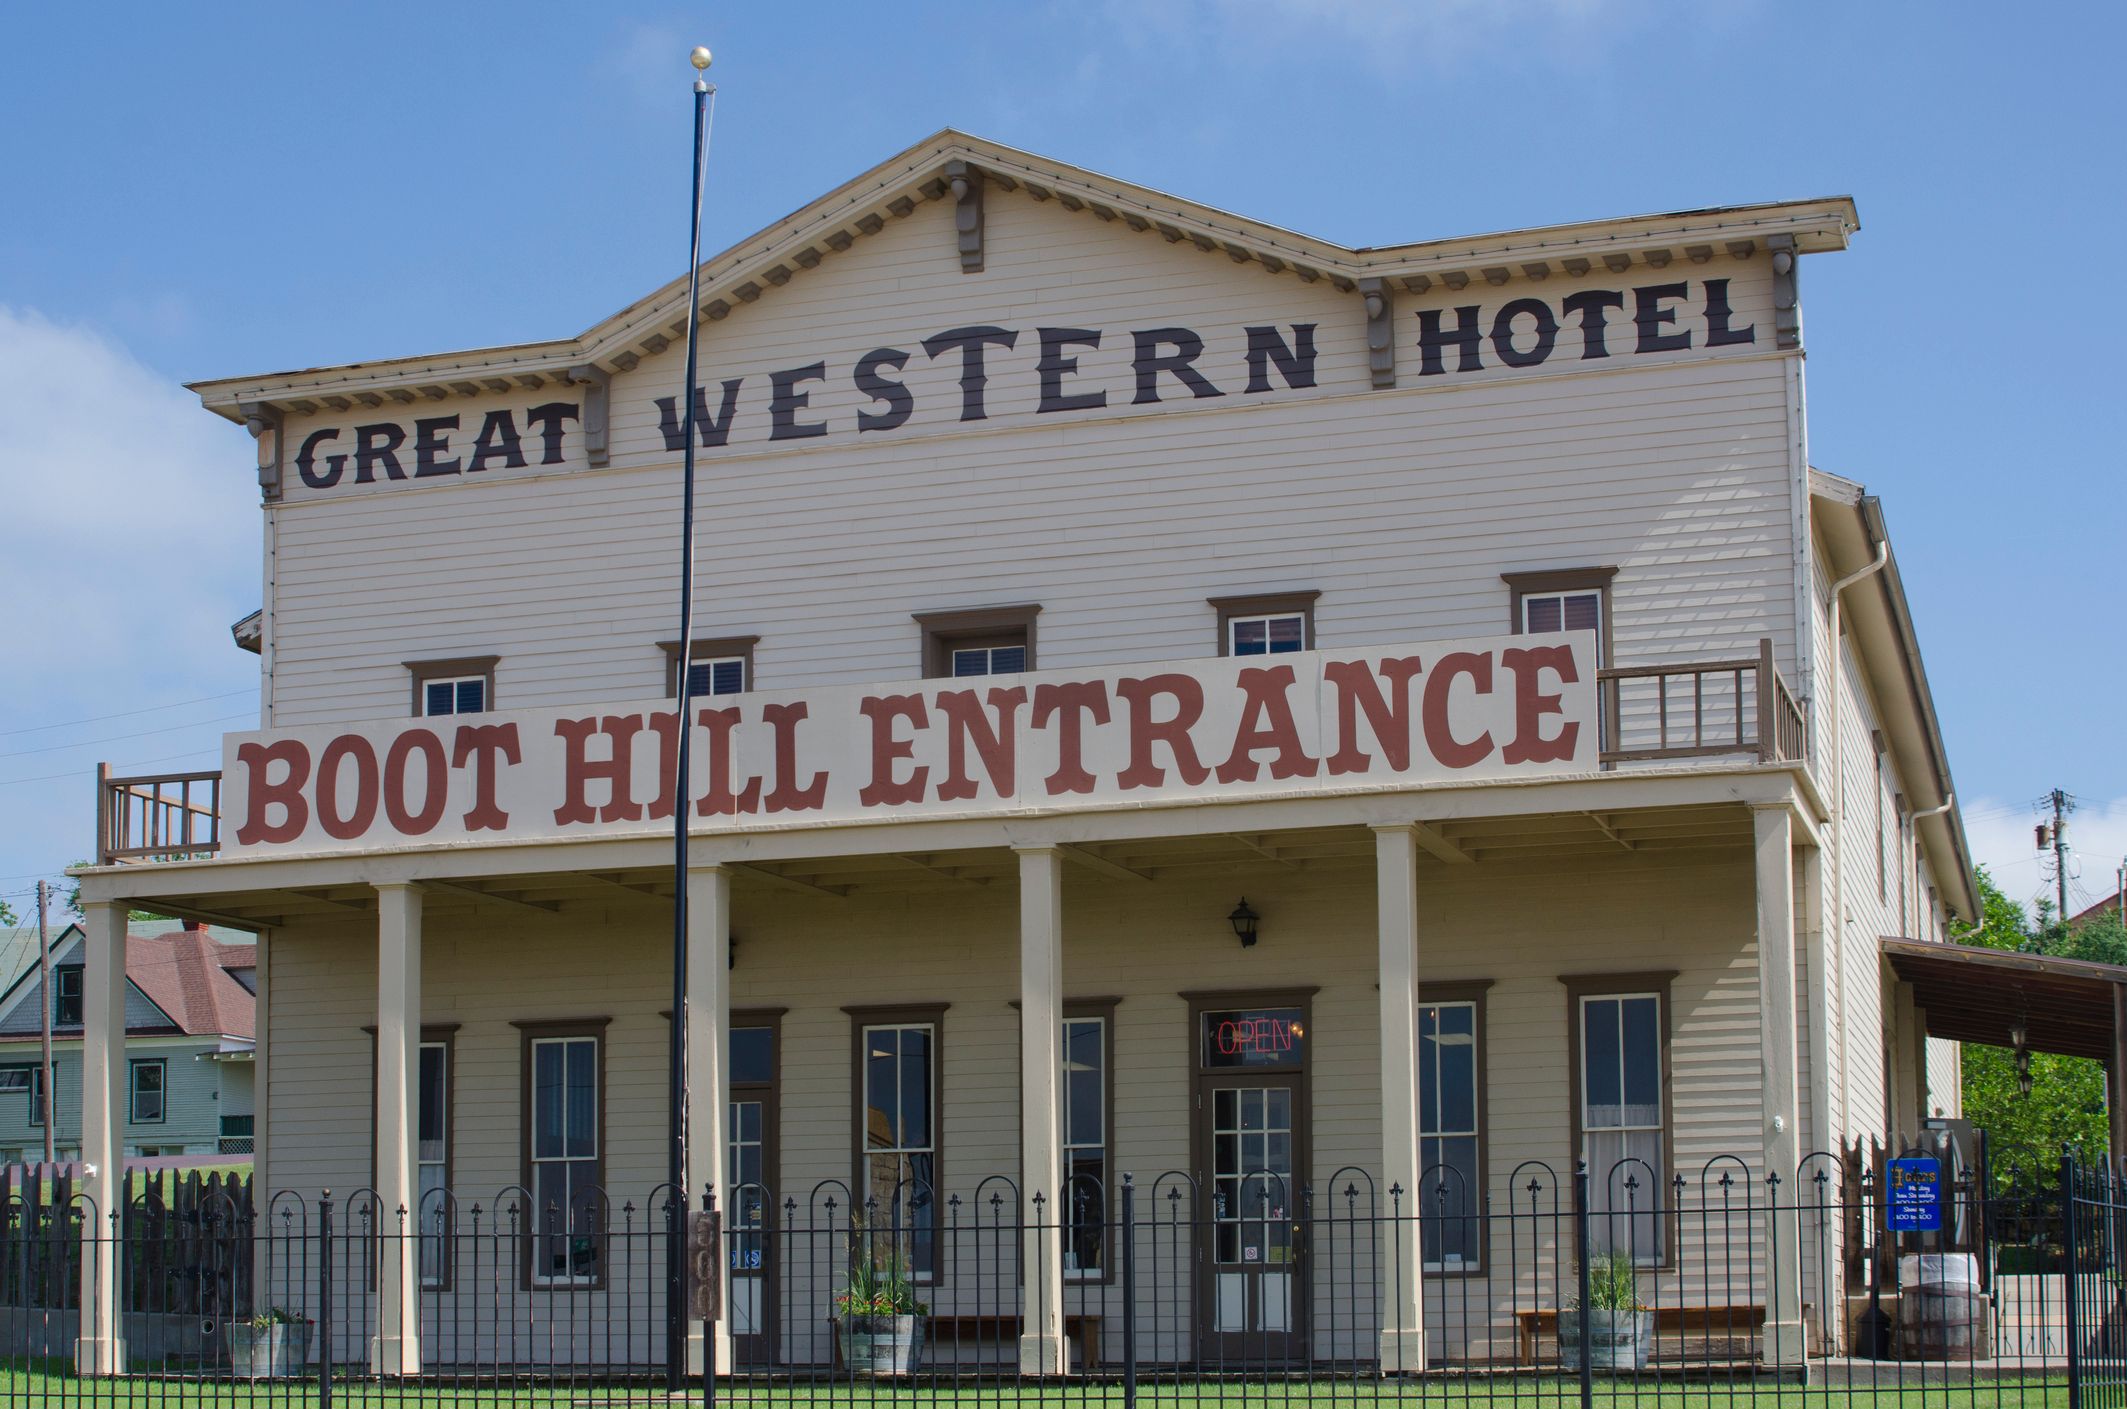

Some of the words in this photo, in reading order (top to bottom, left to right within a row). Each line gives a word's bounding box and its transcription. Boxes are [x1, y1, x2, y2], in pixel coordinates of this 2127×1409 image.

[294, 402, 579, 489] GREAT
[653, 323, 1319, 452] WESTERN
[1414, 278, 1755, 376] HOTEL
[236, 722, 522, 846] BOOT
[553, 700, 829, 826] HILL
[859, 644, 1581, 807] ENTRANCE
[1218, 1019, 1291, 1055] OPEN
